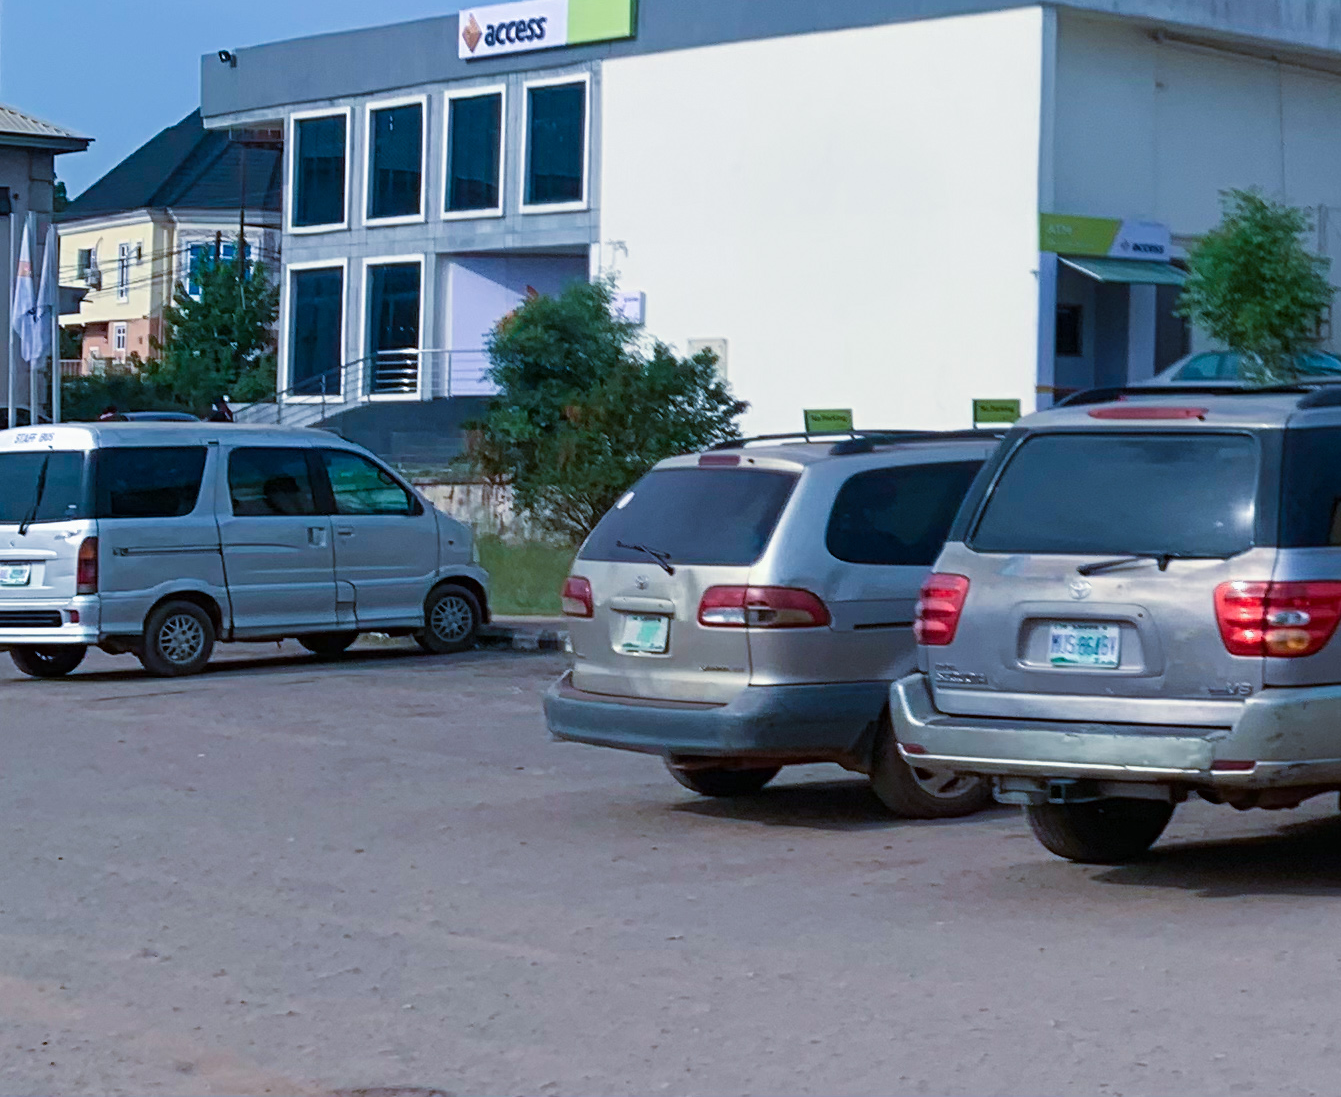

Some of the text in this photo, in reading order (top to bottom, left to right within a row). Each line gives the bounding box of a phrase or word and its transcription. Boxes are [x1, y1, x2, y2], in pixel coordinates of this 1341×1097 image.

[484, 16, 547, 46] access
[14, 432, 55, 443] STAFF BUS
